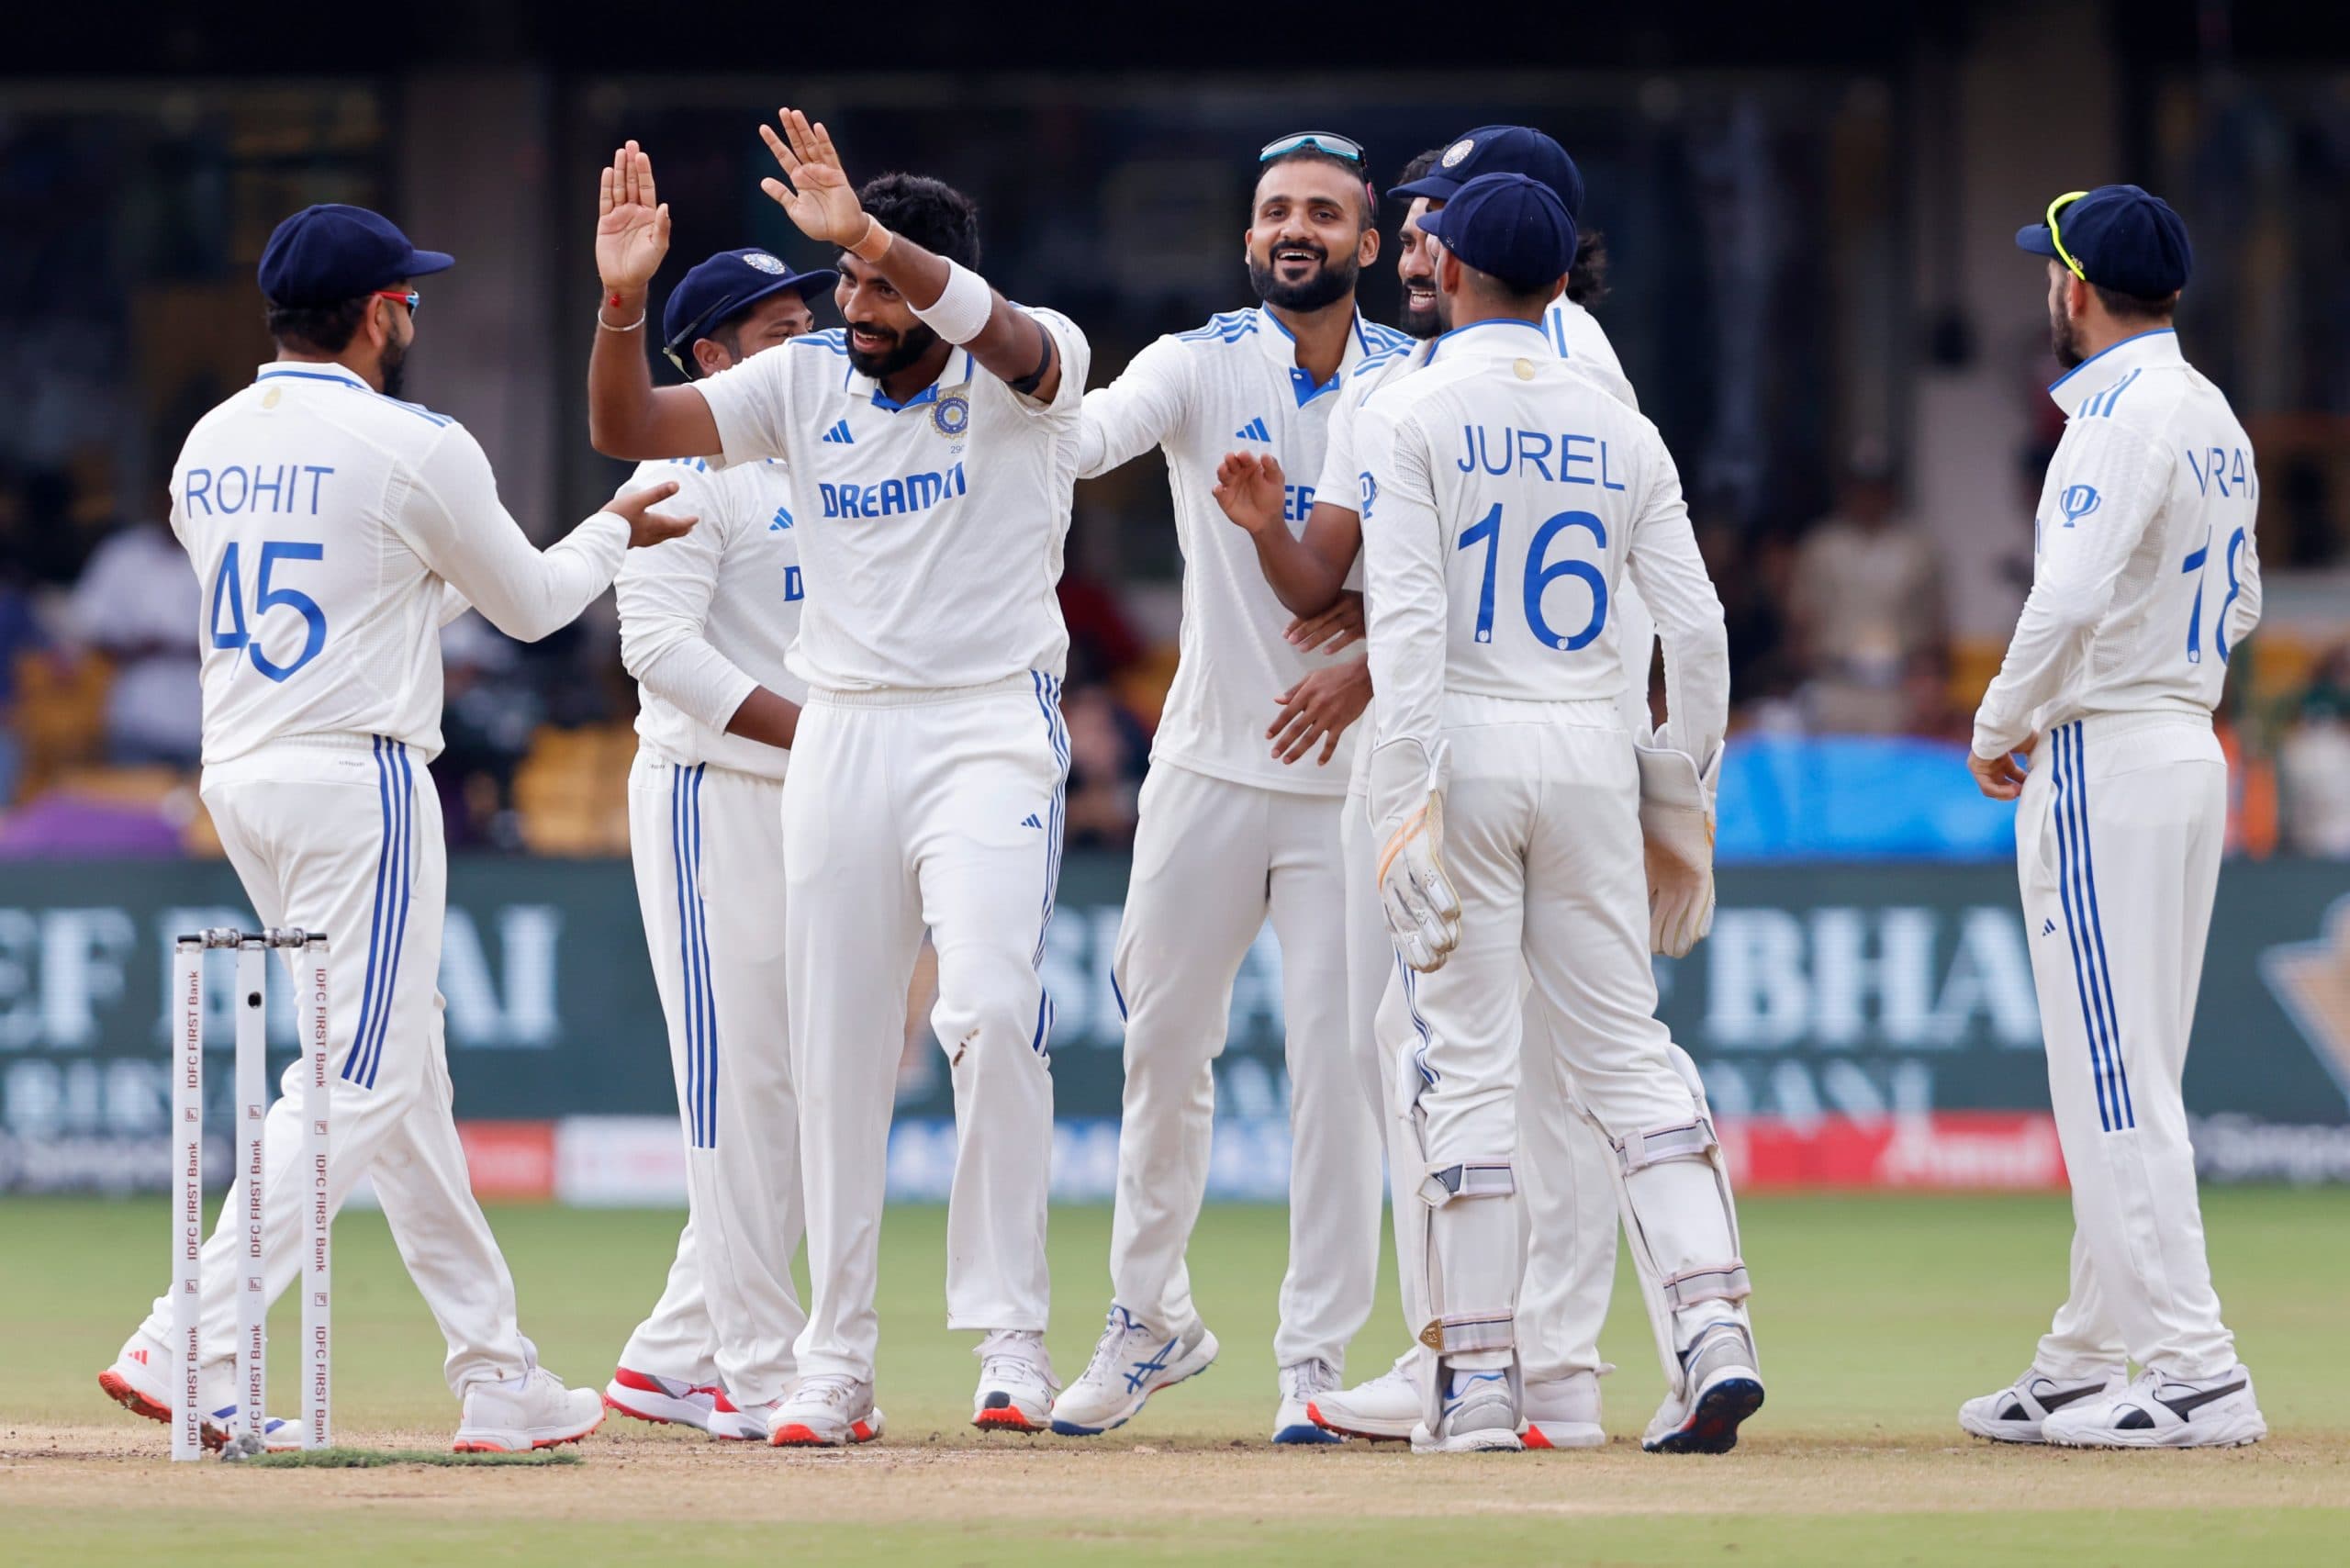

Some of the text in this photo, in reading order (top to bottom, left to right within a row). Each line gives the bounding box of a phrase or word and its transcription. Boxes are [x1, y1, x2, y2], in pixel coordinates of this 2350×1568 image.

[185, 465, 334, 519] ROHIT
[1457, 424, 1625, 492] JUREL
[210, 542, 327, 683] 45
[1458, 502, 1608, 652] 16
[187, 970, 198, 1088] IDFC FIRST Bank
[316, 969, 326, 1087] IDFC FIRST Bank
[187, 1142, 197, 1260] IDFC FIRST Bank
[251, 1139, 261, 1257] IDFC FIRST Bank
[316, 1154, 326, 1271] IDFC FIRST Bank
[187, 1326, 197, 1446] IDFC FIRST Bank
[251, 1324, 261, 1359] Bank
[251, 1365, 261, 1406] FIRST
[316, 1326, 326, 1443] IDFC FIRST Bank
